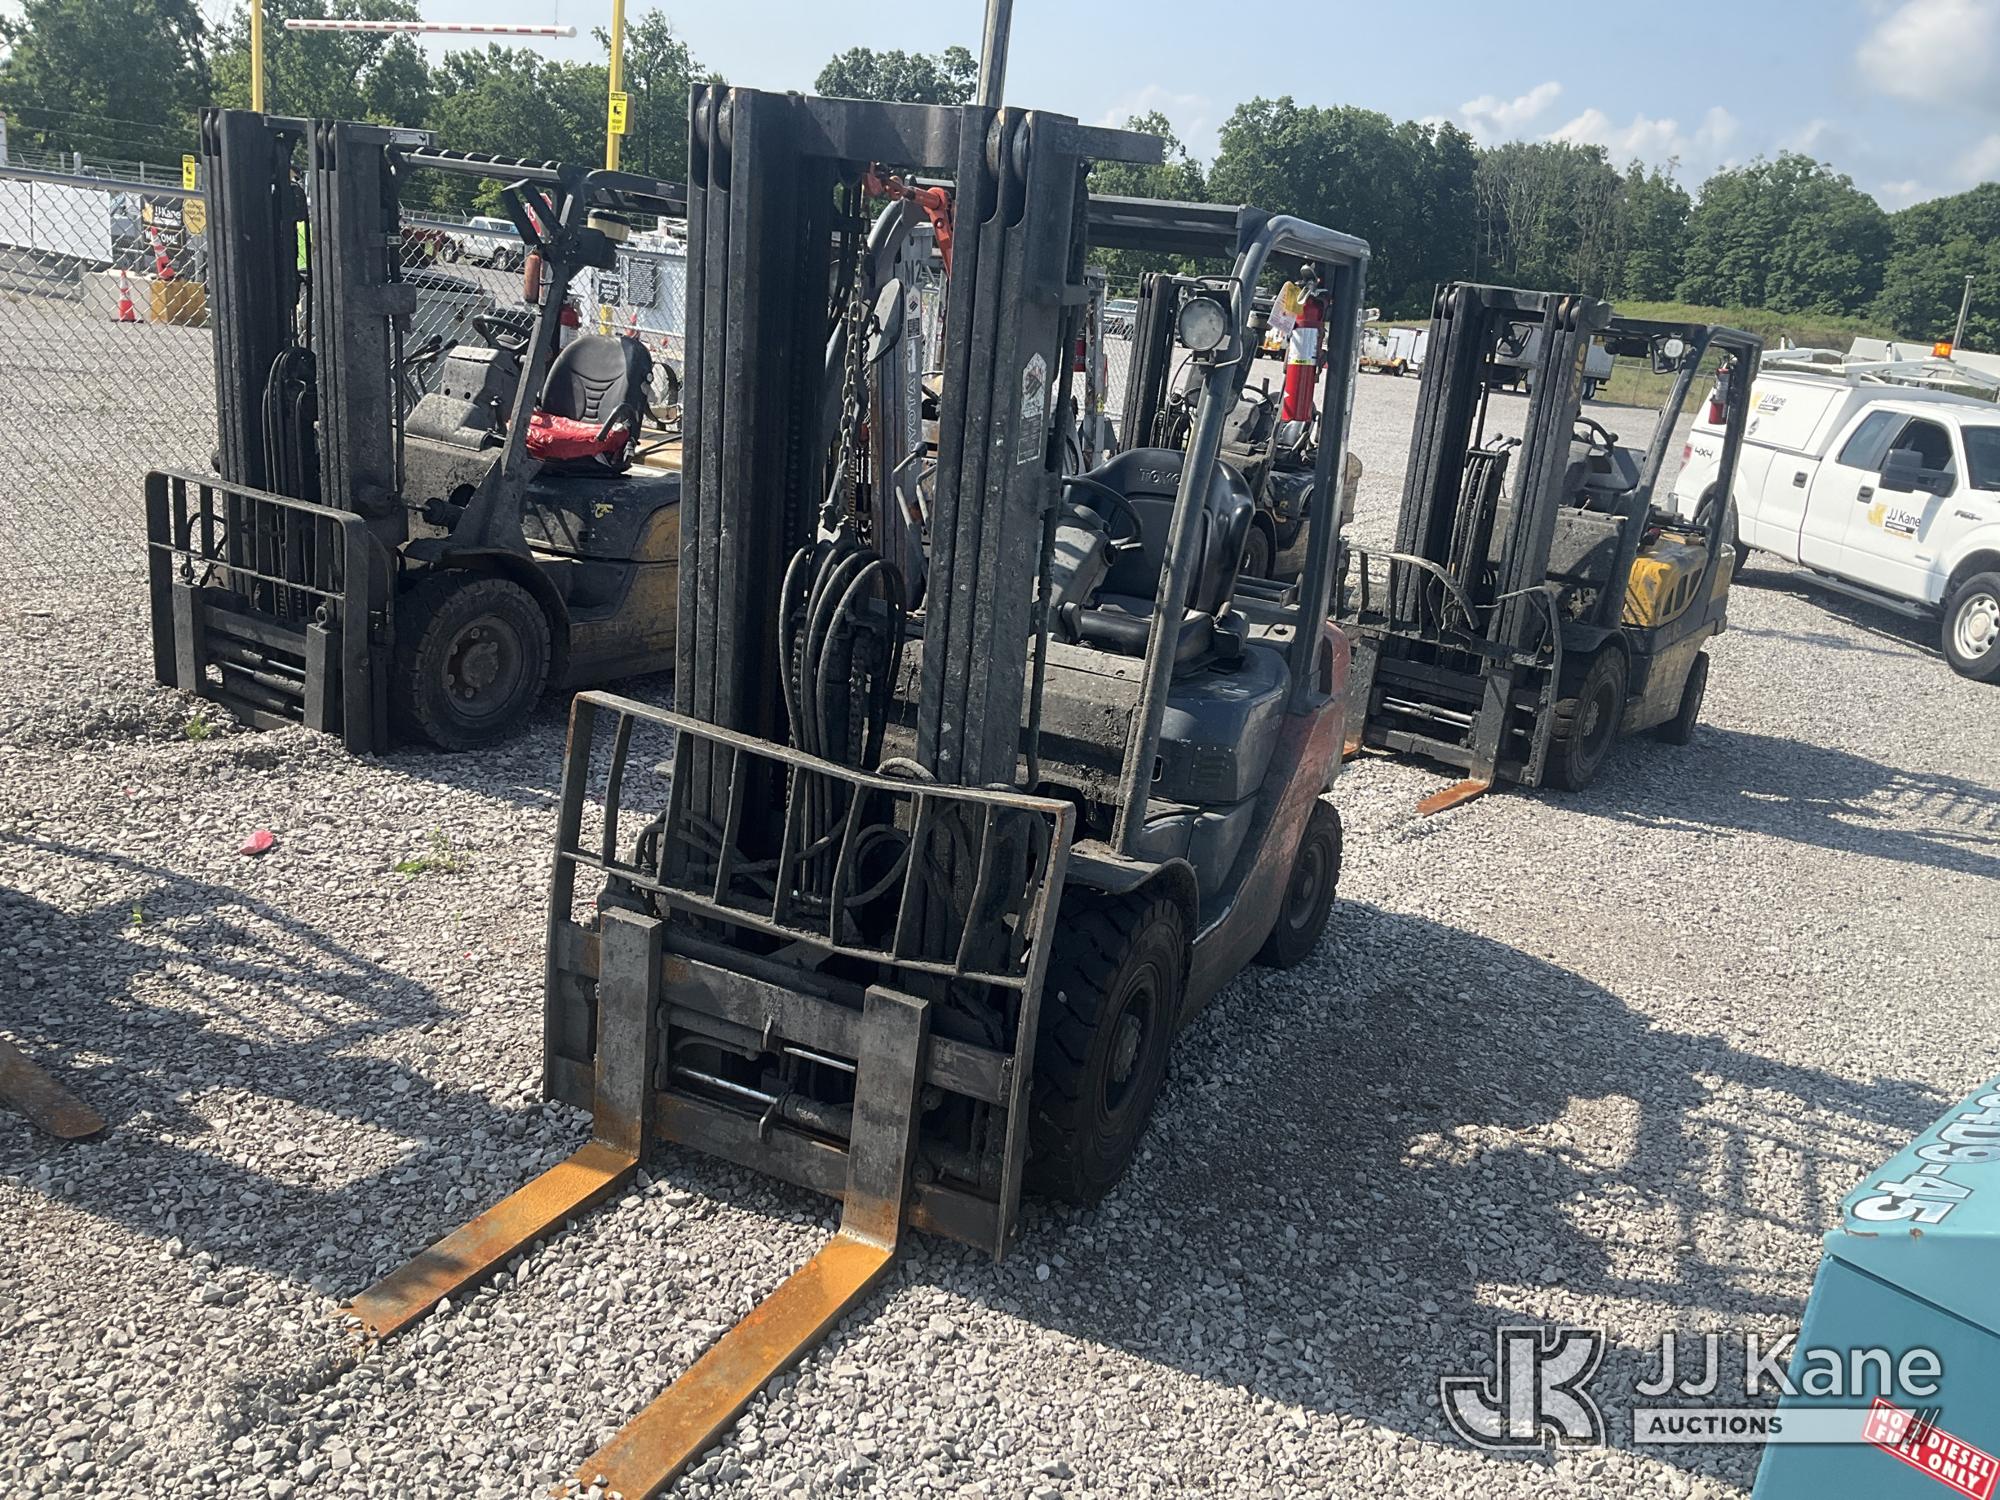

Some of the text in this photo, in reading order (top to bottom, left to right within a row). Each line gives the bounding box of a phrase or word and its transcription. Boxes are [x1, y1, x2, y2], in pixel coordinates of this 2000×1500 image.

[161, 207, 181, 219] Kane
[1139, 468, 1180, 486] TOYO
[1887, 507, 1921, 527] JJ Kane
[1875, 1423, 1980, 1490] FUEL ONLY
[1926, 1431, 1990, 1478] DIESEL
